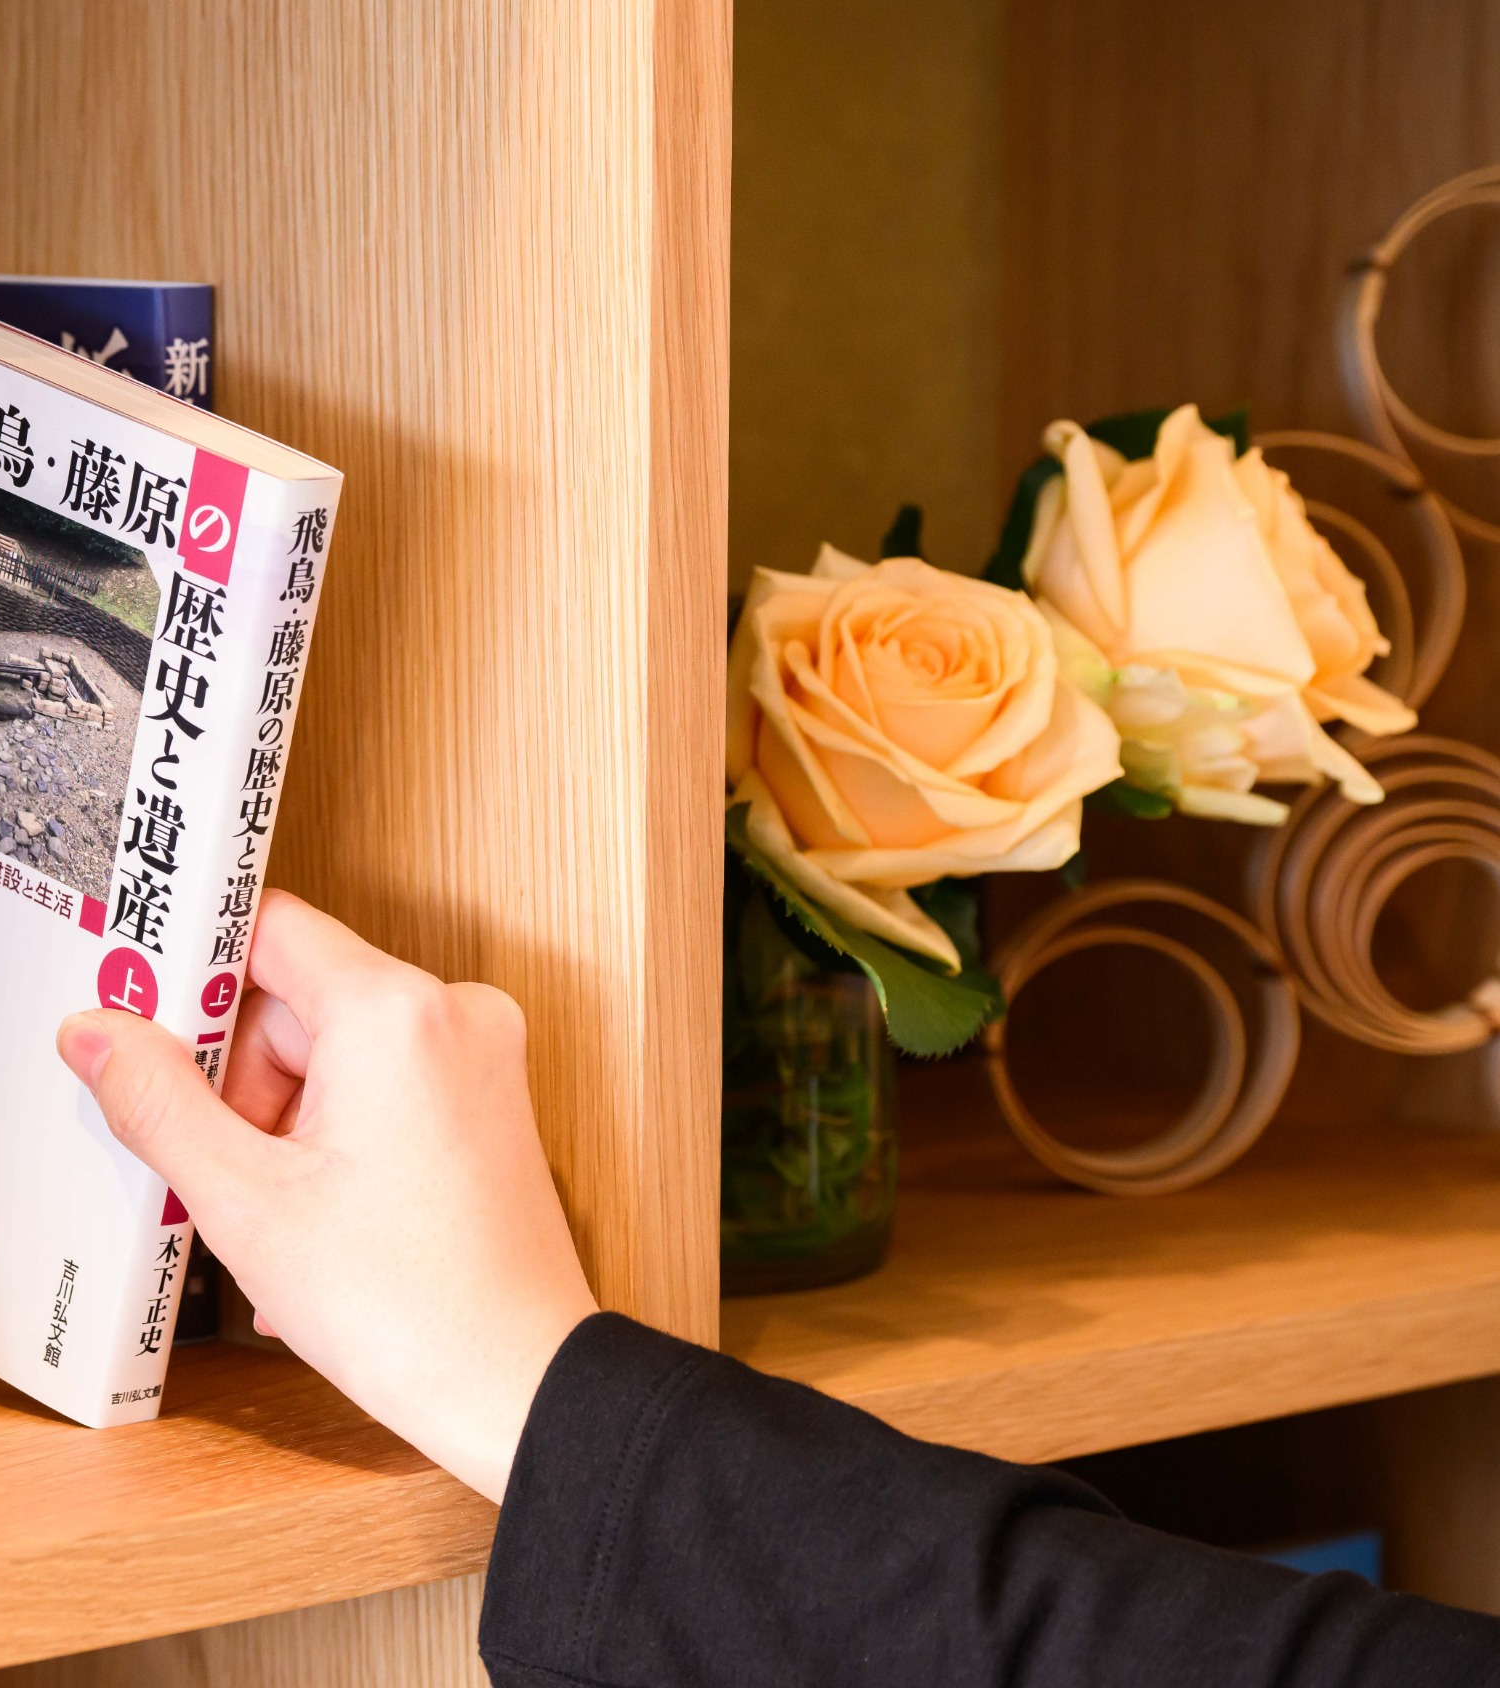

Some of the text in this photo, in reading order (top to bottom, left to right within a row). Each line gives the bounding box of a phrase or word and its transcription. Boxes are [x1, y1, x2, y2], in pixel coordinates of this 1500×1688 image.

[164, 337, 210, 405] 新
[206, 507, 328, 967] 飛鳥・藤原の歴史と遺産
[109, 967, 143, 1015] 上
[208, 982, 230, 1007] 上
[43, 1258, 79, 1369] 吉川弘文館
[134, 1233, 183, 1357] 木下正史
[111, 1384, 162, 1405] 吉川弘文館
